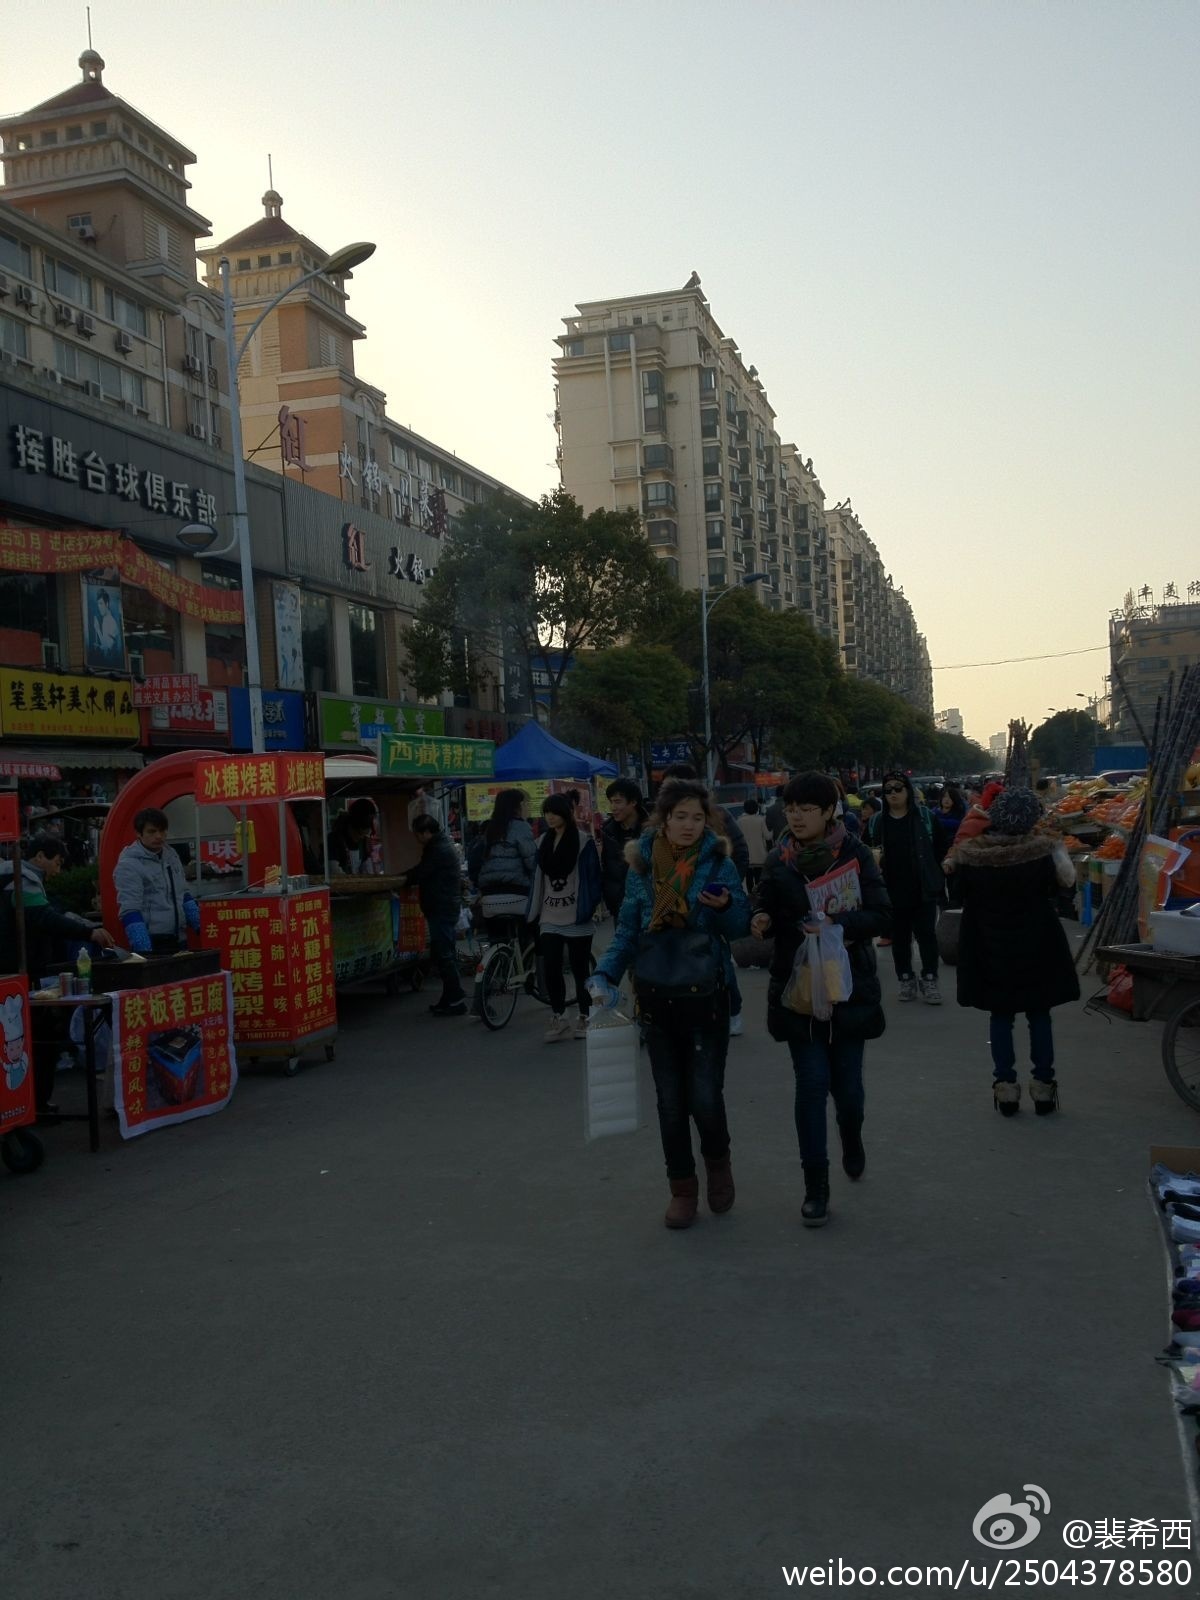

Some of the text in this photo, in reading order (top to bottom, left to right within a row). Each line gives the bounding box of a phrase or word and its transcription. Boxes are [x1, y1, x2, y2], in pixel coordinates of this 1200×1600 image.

[15, 424, 217, 524] 挥胜台球俱乐部
[9, 680, 133, 718] 笔墨轩美术用品
[203, 760, 276, 799] 冰糖烤梨
[228, 925, 264, 1016] 冰糖烤梨
[124, 981, 225, 1030] 铁板香豆腐
